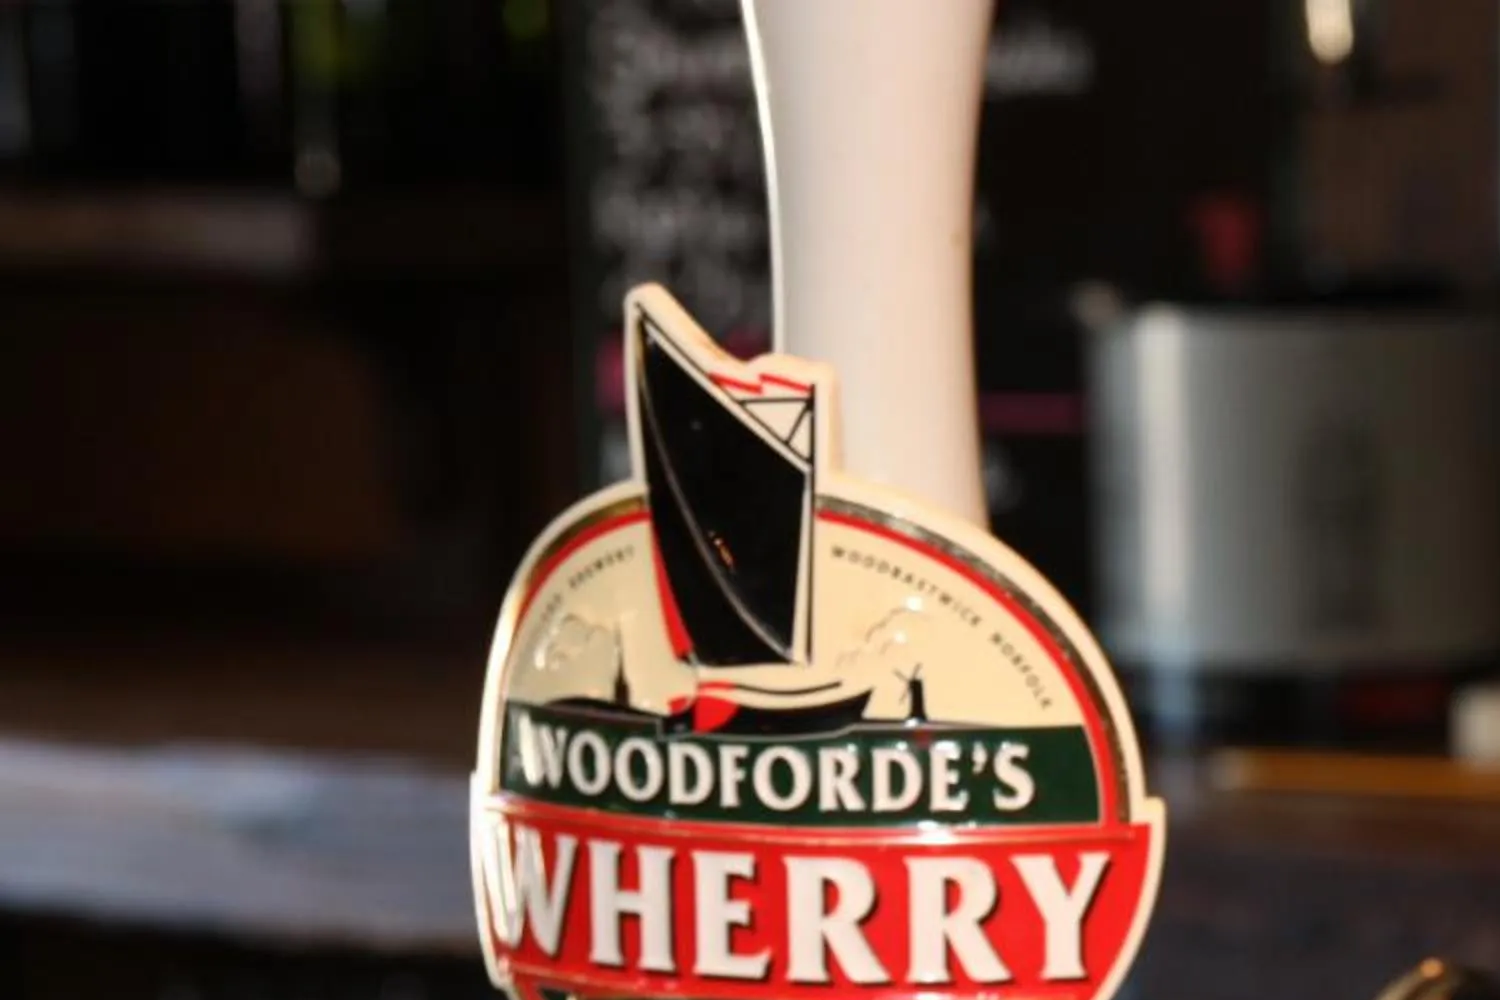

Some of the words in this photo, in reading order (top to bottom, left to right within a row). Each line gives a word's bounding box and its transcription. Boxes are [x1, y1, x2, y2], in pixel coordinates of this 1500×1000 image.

[990, 631, 1053, 710] NORFOLK
[516, 708, 1036, 813] WOODFORDE'S
[482, 812, 1113, 985] WHERRY
